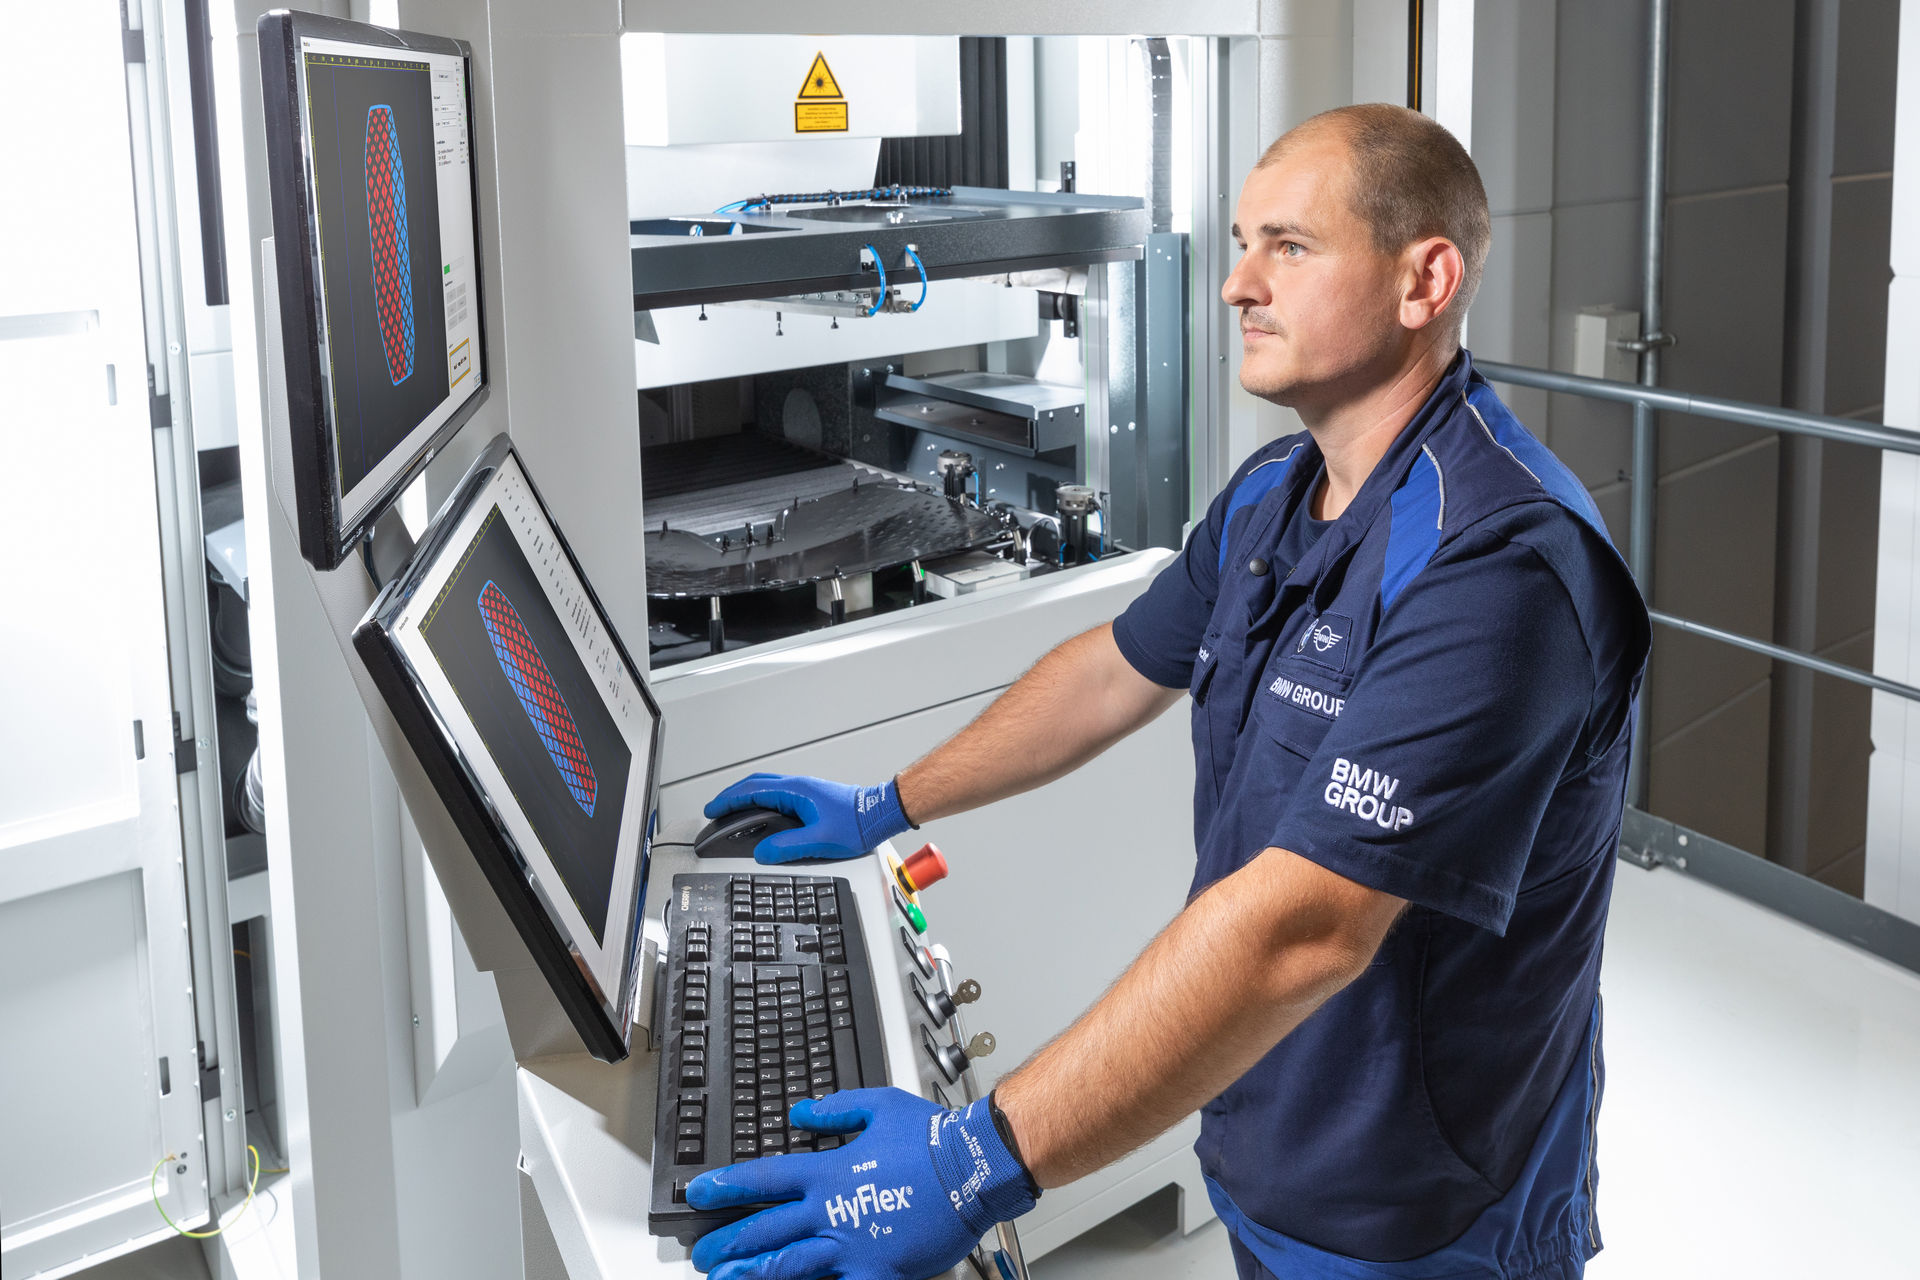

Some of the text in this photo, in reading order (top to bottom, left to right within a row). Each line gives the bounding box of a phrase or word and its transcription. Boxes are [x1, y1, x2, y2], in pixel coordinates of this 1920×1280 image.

[1269, 676, 1293, 698] BMW
[1330, 757, 1400, 800] BMW
[1324, 781, 1415, 832] GROUP
[681, 890, 690, 911] CHERRY
[764, 1138, 773, 1146] W
[851, 1159, 878, 1174] 11-818
